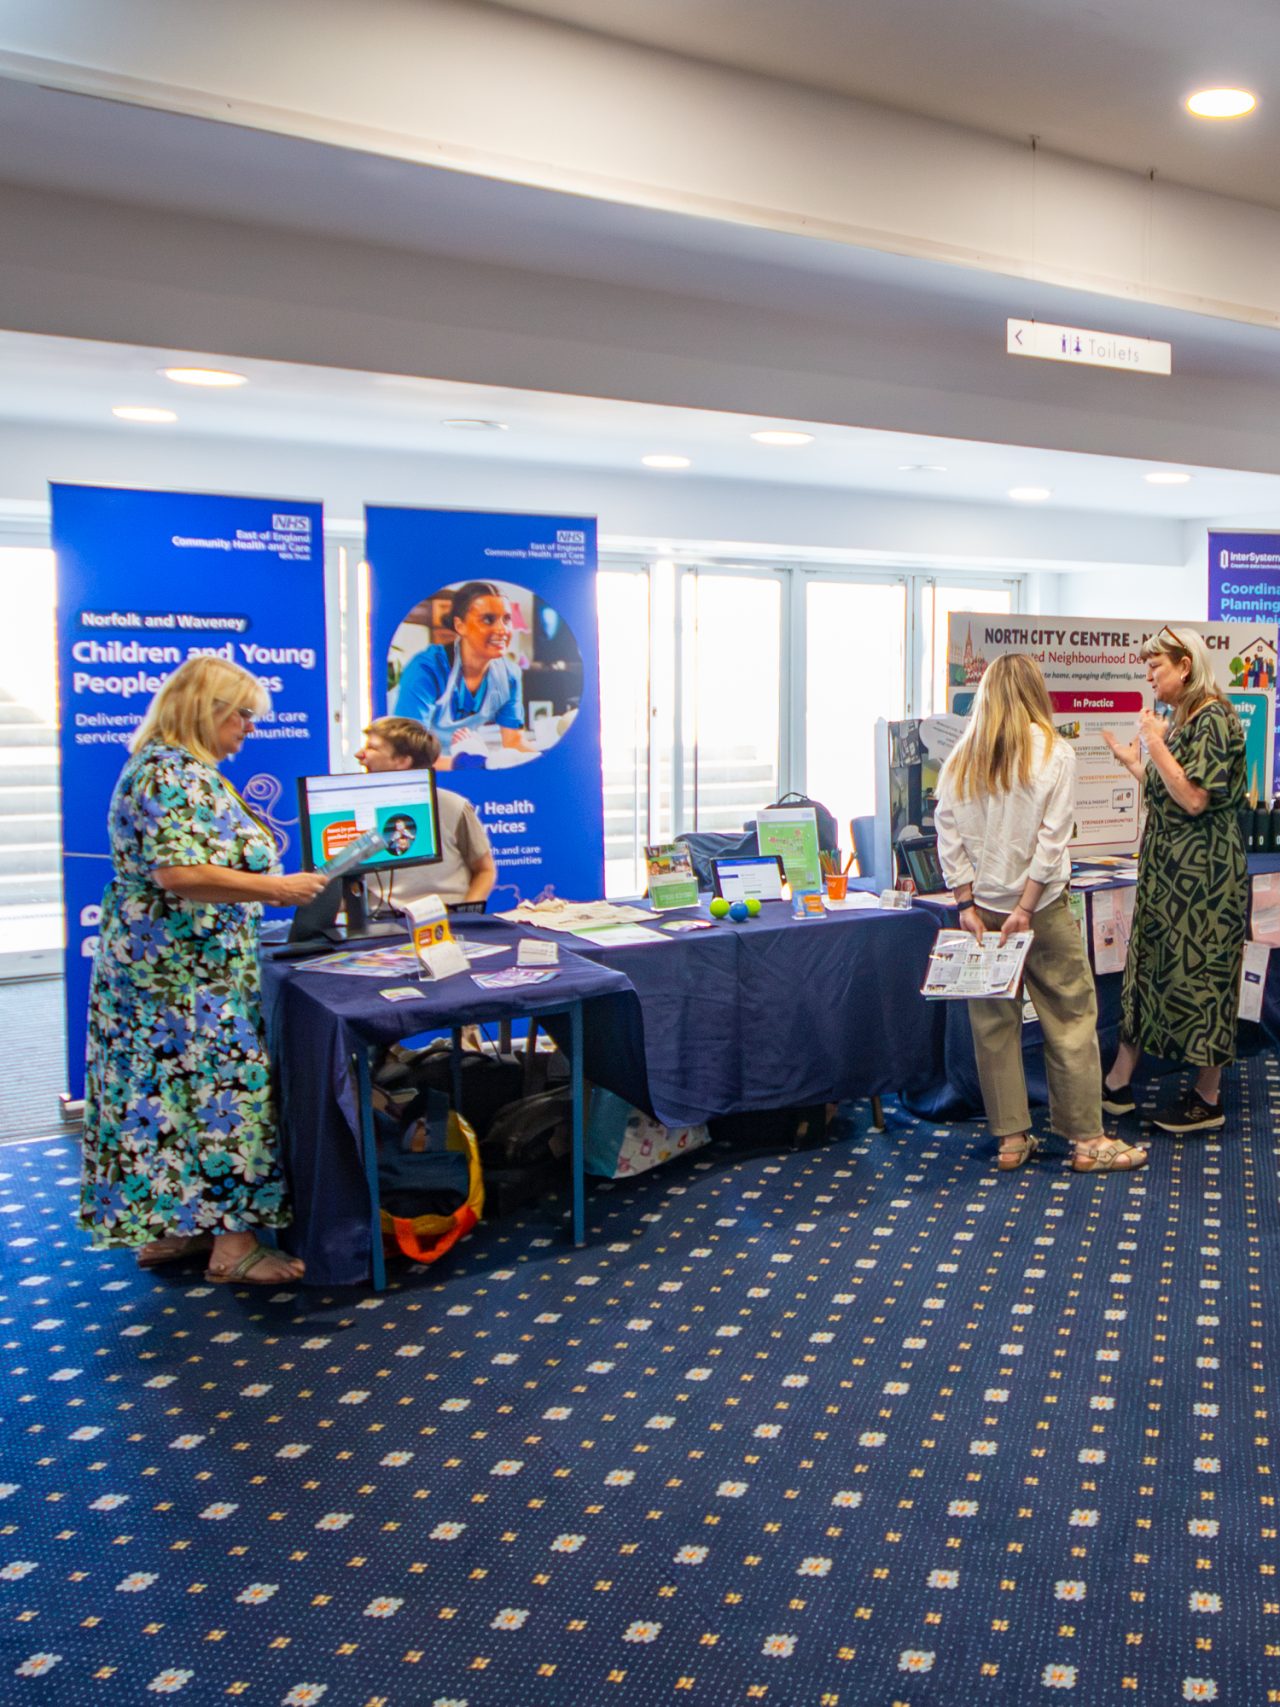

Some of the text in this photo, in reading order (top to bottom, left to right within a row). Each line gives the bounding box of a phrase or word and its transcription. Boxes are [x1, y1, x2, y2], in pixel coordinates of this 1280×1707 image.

[1089, 339, 1140, 363] Toilets
[274, 515, 308, 530] NHS
[171, 536, 231, 551] Community
[232, 539, 265, 551] Health
[557, 531, 584, 543] NHS
[1221, 598, 1280, 613] Planning
[81, 612, 247, 632] Norfolk and Waveney
[985, 628, 1028, 644] NORTH
[1031, 629, 1066, 646] CITY
[1069, 630, 1130, 647] CENTRE
[72, 640, 181, 664] Children
[240, 643, 316, 669] Young
[1048, 651, 1126, 666] Neighbourhood
[1051, 671, 1071, 680] home,
[1072, 672, 1099, 681] engaging
[1100, 671, 1132, 681] differently,
[1073, 698, 1114, 708] In Practice
[75, 712, 145, 727] Deliverin
[278, 712, 308, 723] care
[484, 799, 535, 816] Health
[484, 819, 527, 834] rvices
[502, 845, 519, 856] and
[521, 845, 541, 855] care
